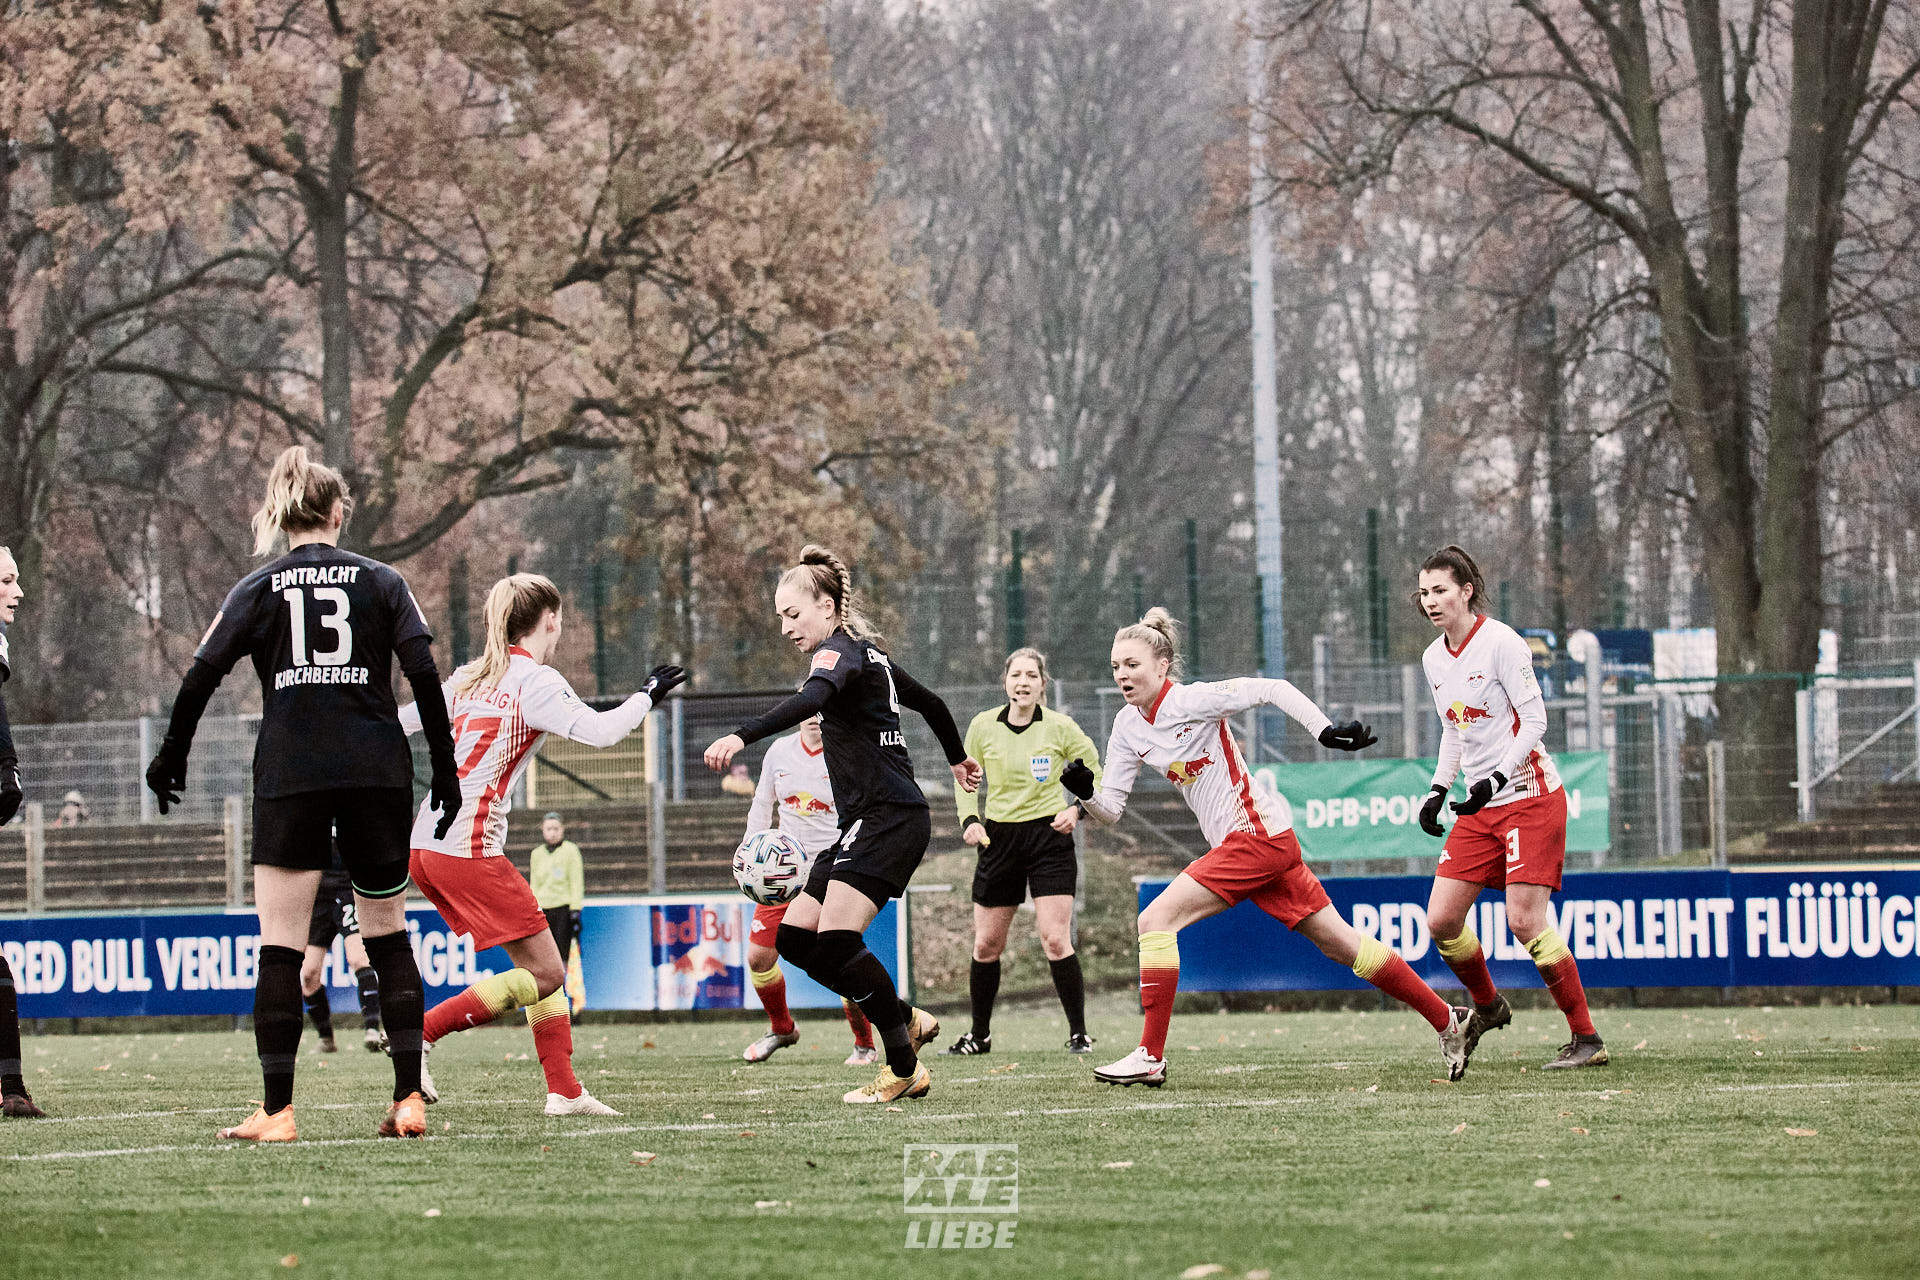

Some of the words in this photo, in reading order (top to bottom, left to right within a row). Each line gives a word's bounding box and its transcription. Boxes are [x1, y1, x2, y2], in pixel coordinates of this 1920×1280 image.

[271, 566, 360, 593] EINTRACHT
[283, 587, 353, 667] 13
[274, 666, 369, 690] KIRCHBERGER
[840, 818, 863, 851] 4
[1506, 827, 1520, 863] 3
[1546, 898, 1735, 960] VERLEIHT
[1745, 881, 1920, 959] FLÜÜÜG
[3, 940, 67, 995] RED
[72, 938, 153, 993] BULL
